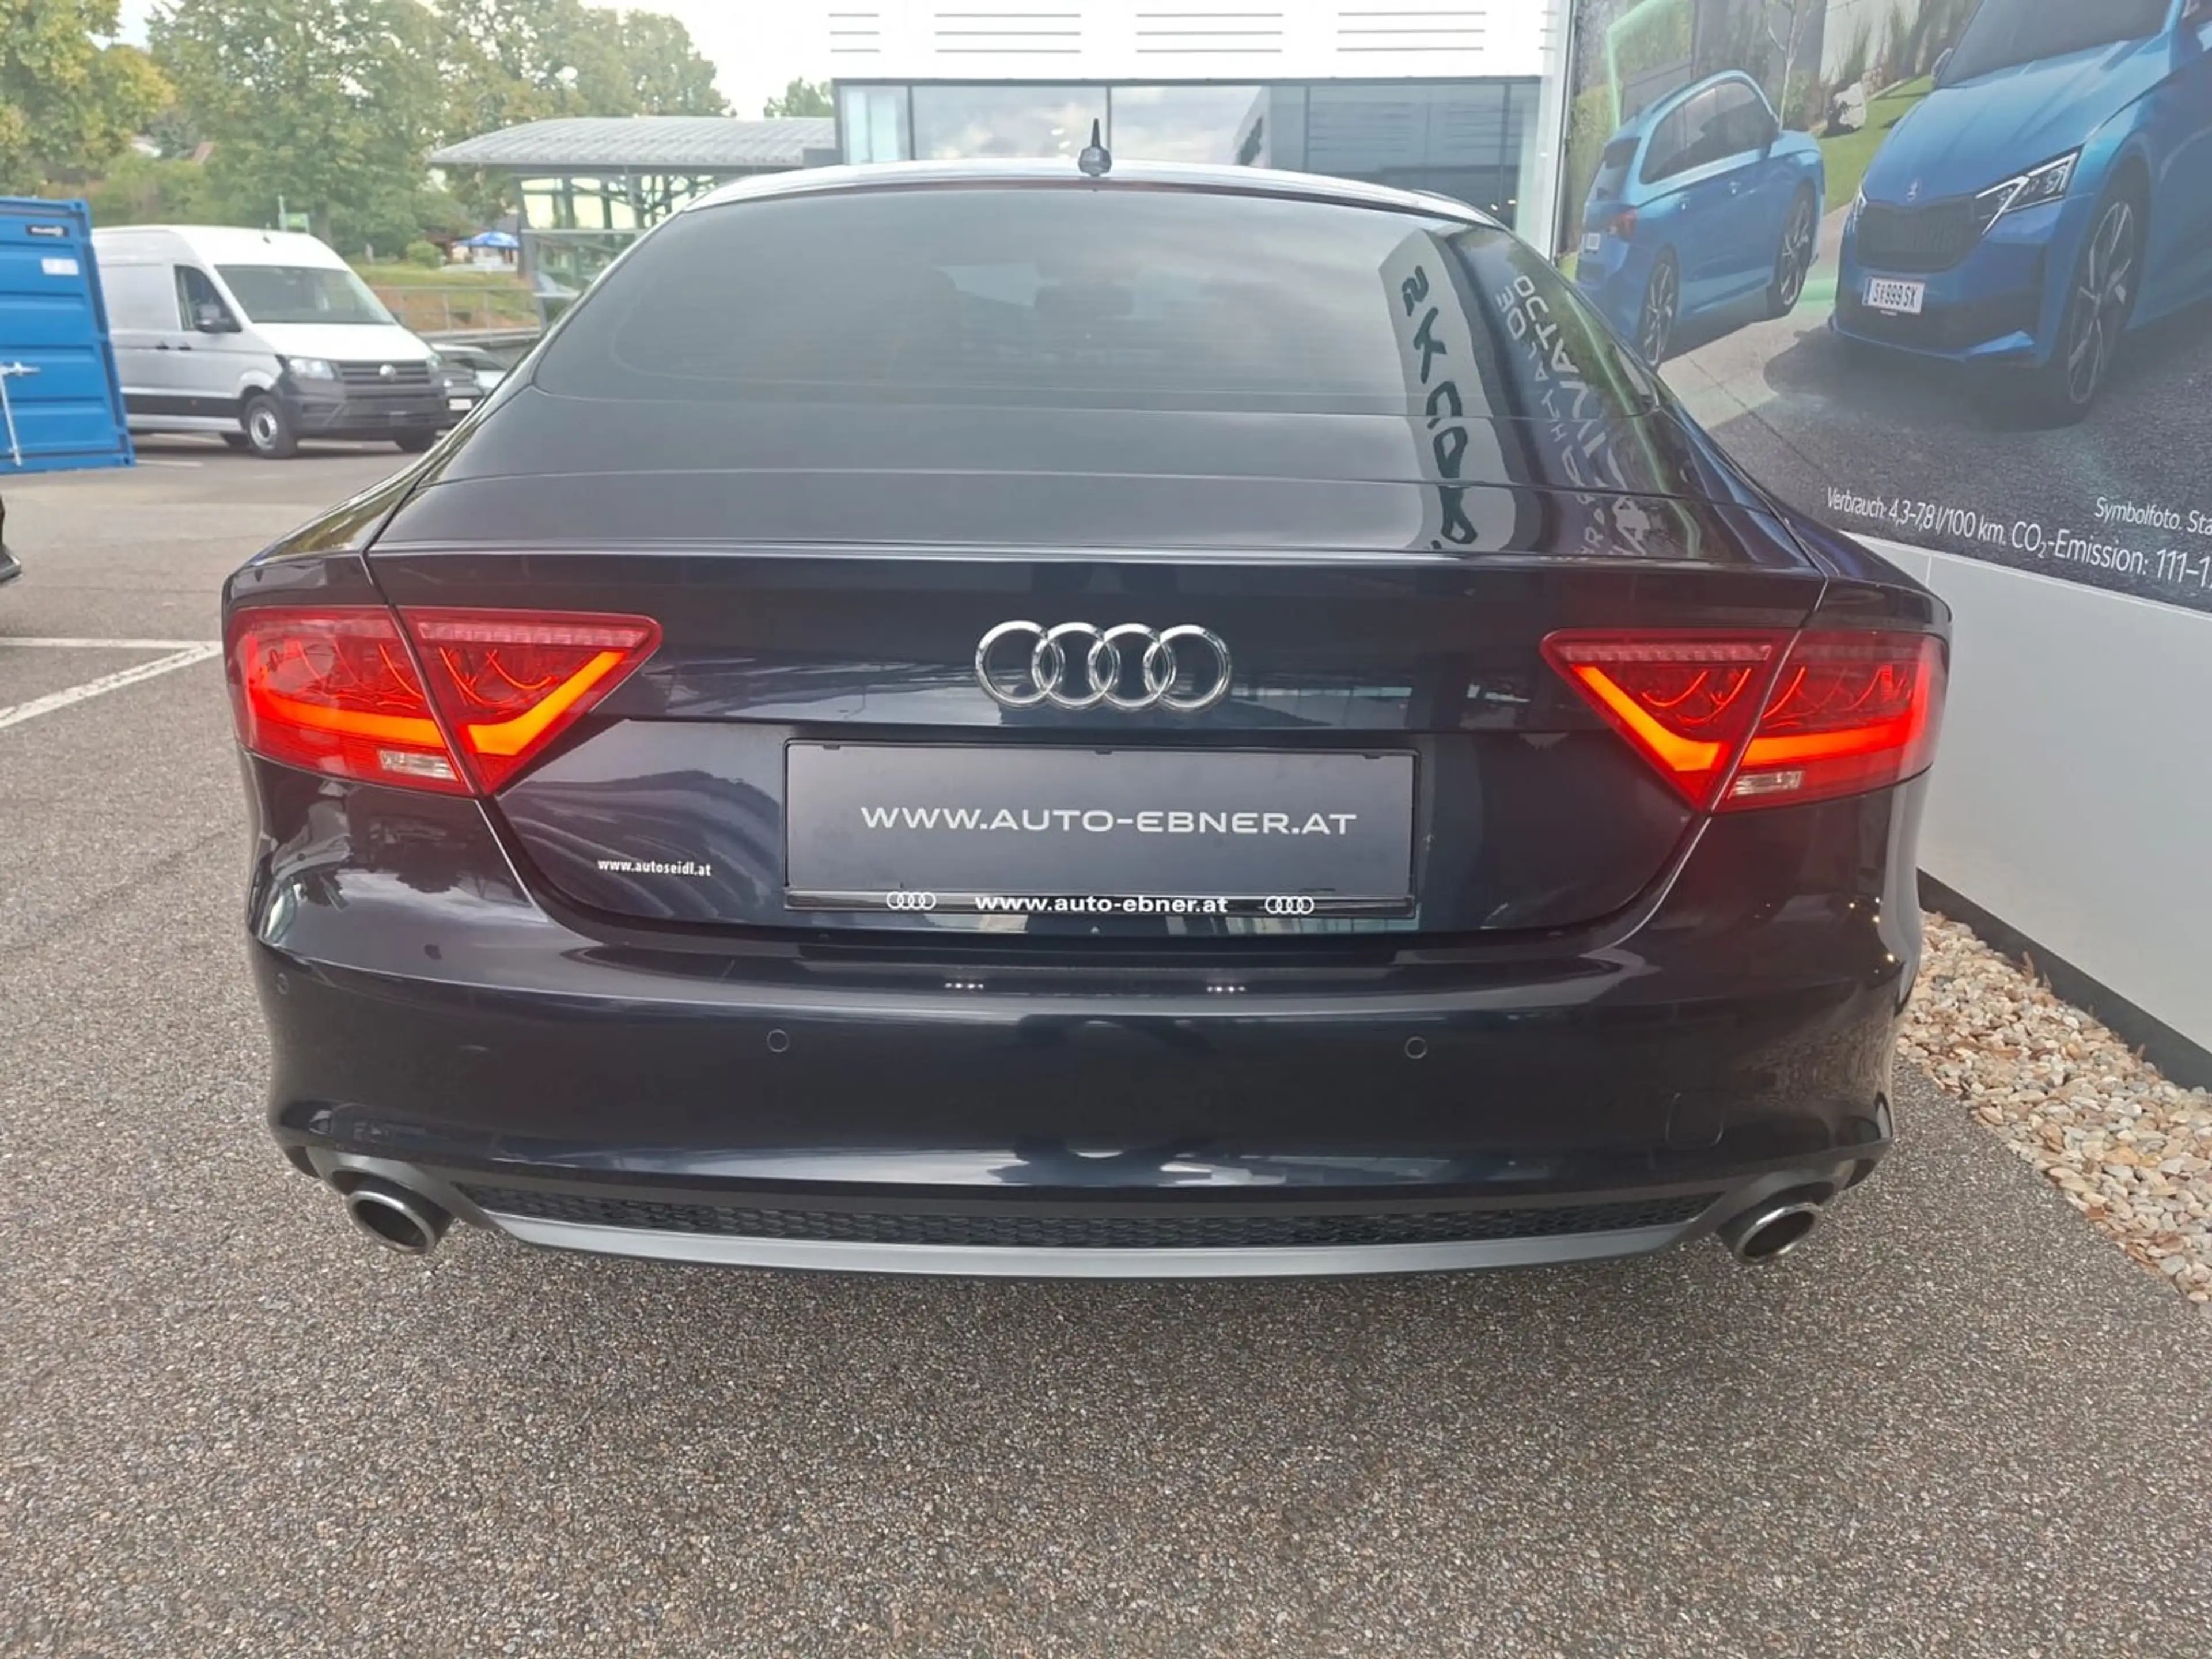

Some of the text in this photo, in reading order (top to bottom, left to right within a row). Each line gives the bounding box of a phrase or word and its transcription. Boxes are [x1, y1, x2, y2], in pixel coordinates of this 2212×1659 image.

[2094, 497, 2183, 531] Symbolfoto.
[2156, 548, 2212, 589] 111-1
[861, 806, 1357, 835] WWW.AUTO-EBNER.AT
[597, 860, 711, 876] www.autoseidl.at
[975, 895, 1228, 914] www.auto-ebner.at
